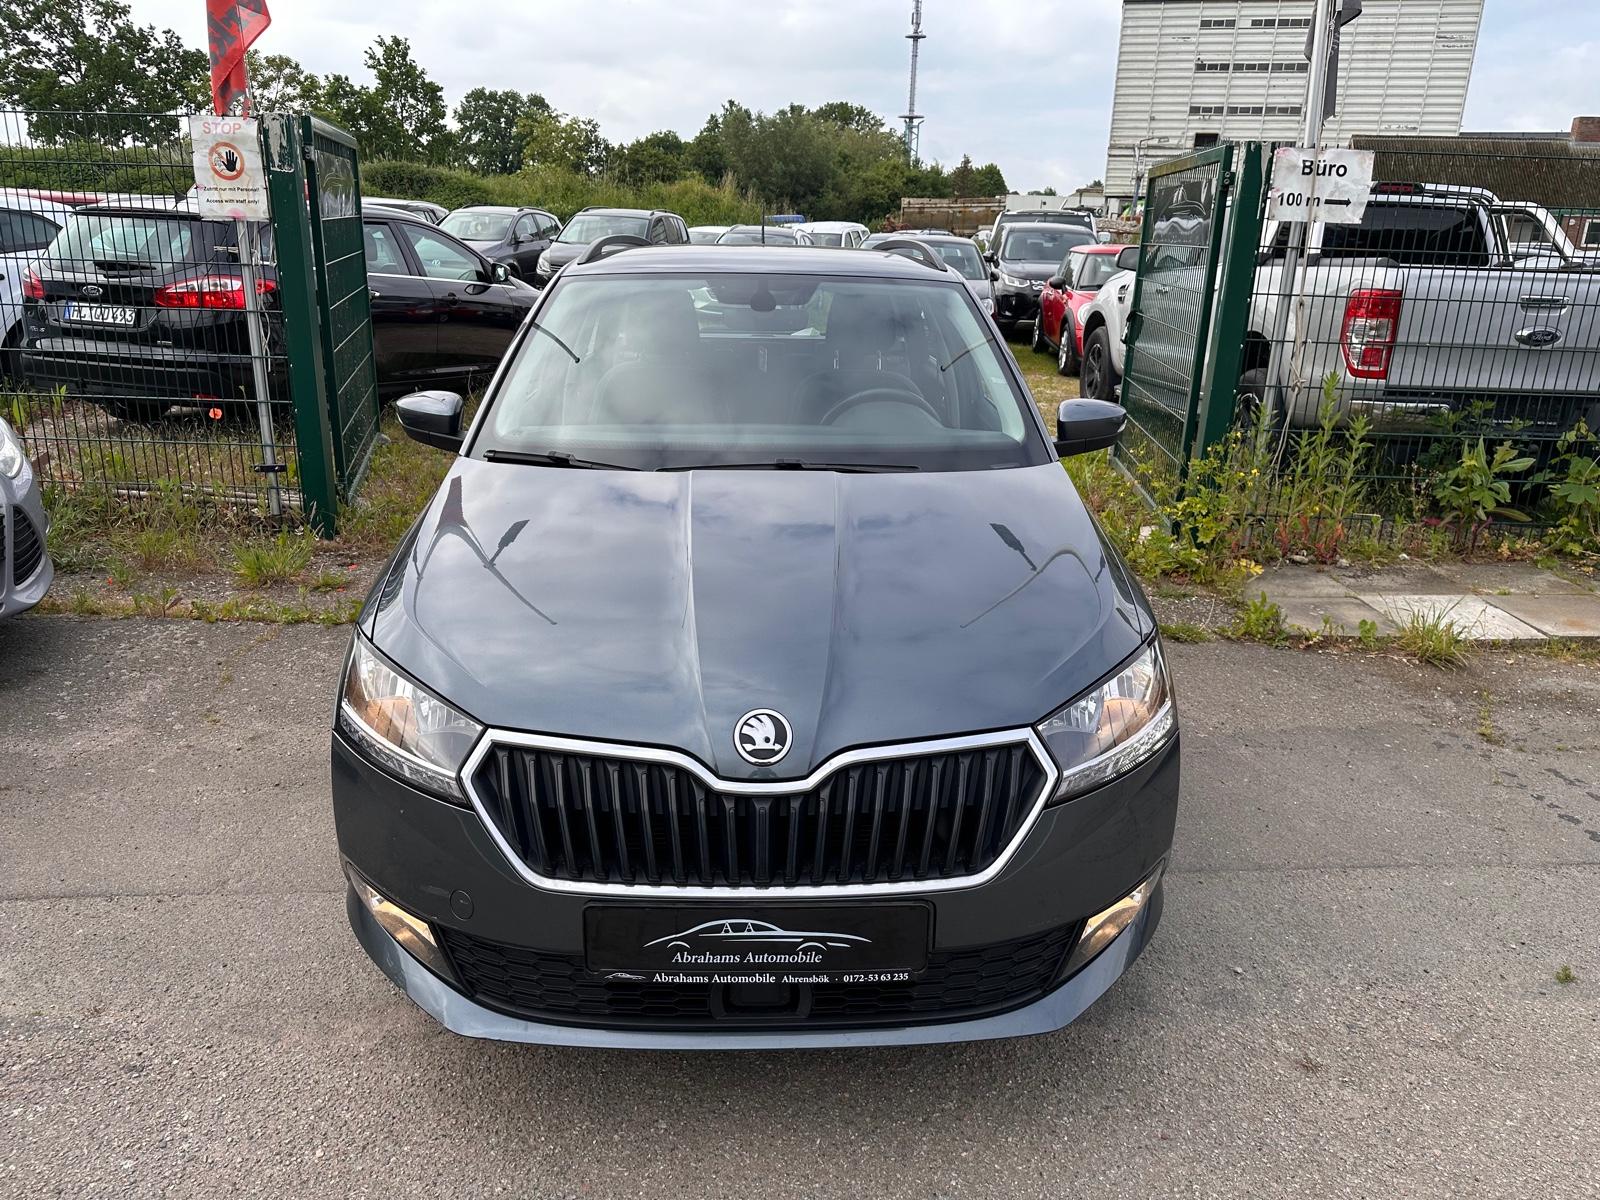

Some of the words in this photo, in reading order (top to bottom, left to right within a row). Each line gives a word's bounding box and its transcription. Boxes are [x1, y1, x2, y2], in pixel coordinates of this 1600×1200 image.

[202, 121, 242, 134] STOP
[1301, 159, 1348, 177] Büro
[1277, 192, 1303, 206] 100
[672, 951, 740, 963] Abrahams
[744, 951, 823, 963] Automobile
[652, 973, 709, 983] Abrahams
[711, 973, 776, 983] Automobile
[781, 974, 830, 983] Ahrensbök
[843, 973, 879, 983] 0172-53
[880, 973, 891, 982] 63
[892, 972, 909, 981] 235
